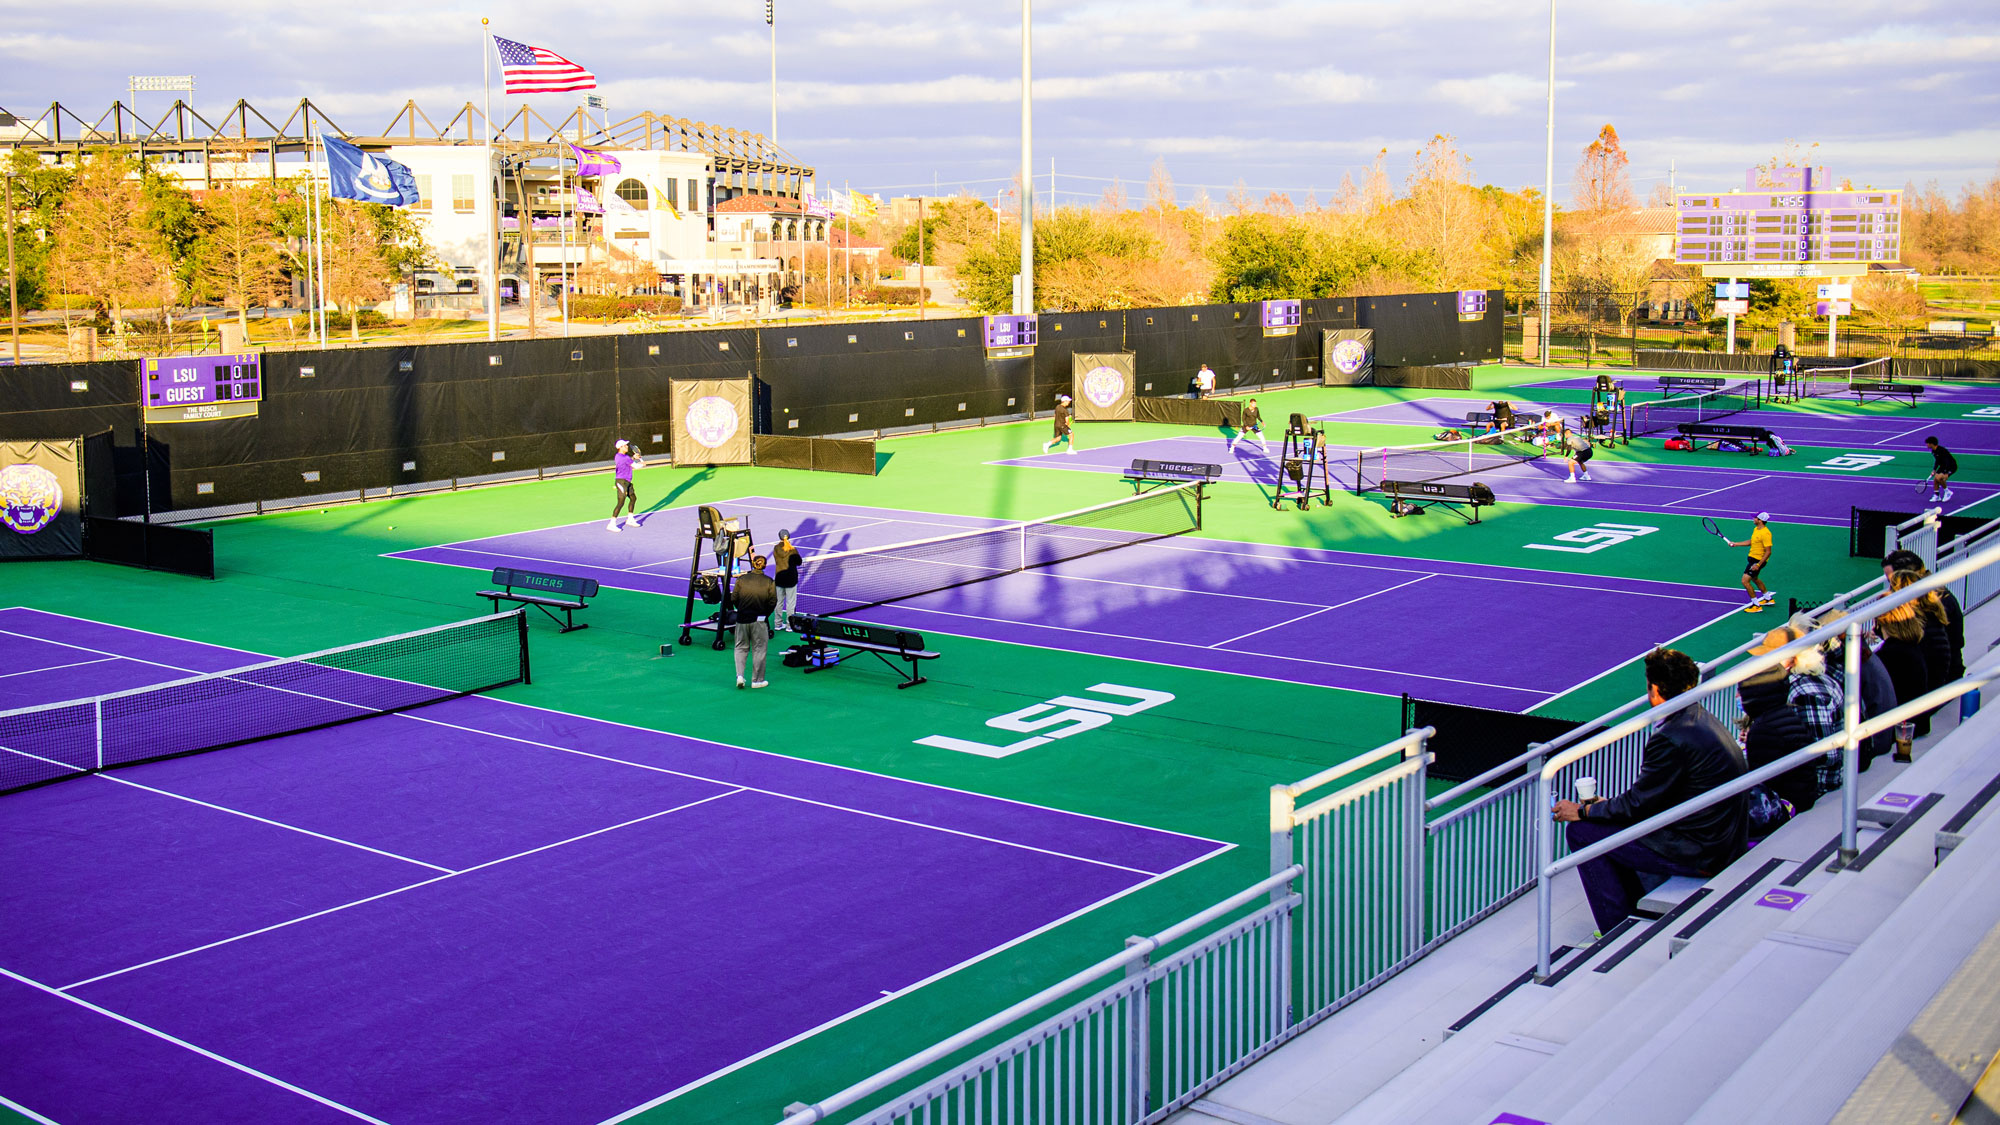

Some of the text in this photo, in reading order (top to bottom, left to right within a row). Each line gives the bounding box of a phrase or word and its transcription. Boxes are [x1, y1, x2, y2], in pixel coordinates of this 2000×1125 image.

[1000, 322, 1010, 332] LSU
[996, 335, 1013, 345] GUEST
[173, 368, 197, 383] LSU
[234, 366, 240, 379] 0
[166, 386, 205, 402] GUEST
[235, 384, 241, 397] 0
[199, 405, 217, 413] BUSCH
[1160, 464, 1193, 472] TIGERS
[1805, 454, 1895, 472] LSU
[1522, 522, 1660, 554] LSU
[525, 575, 564, 588] TIGERS
[912, 682, 1176, 759] LSU
